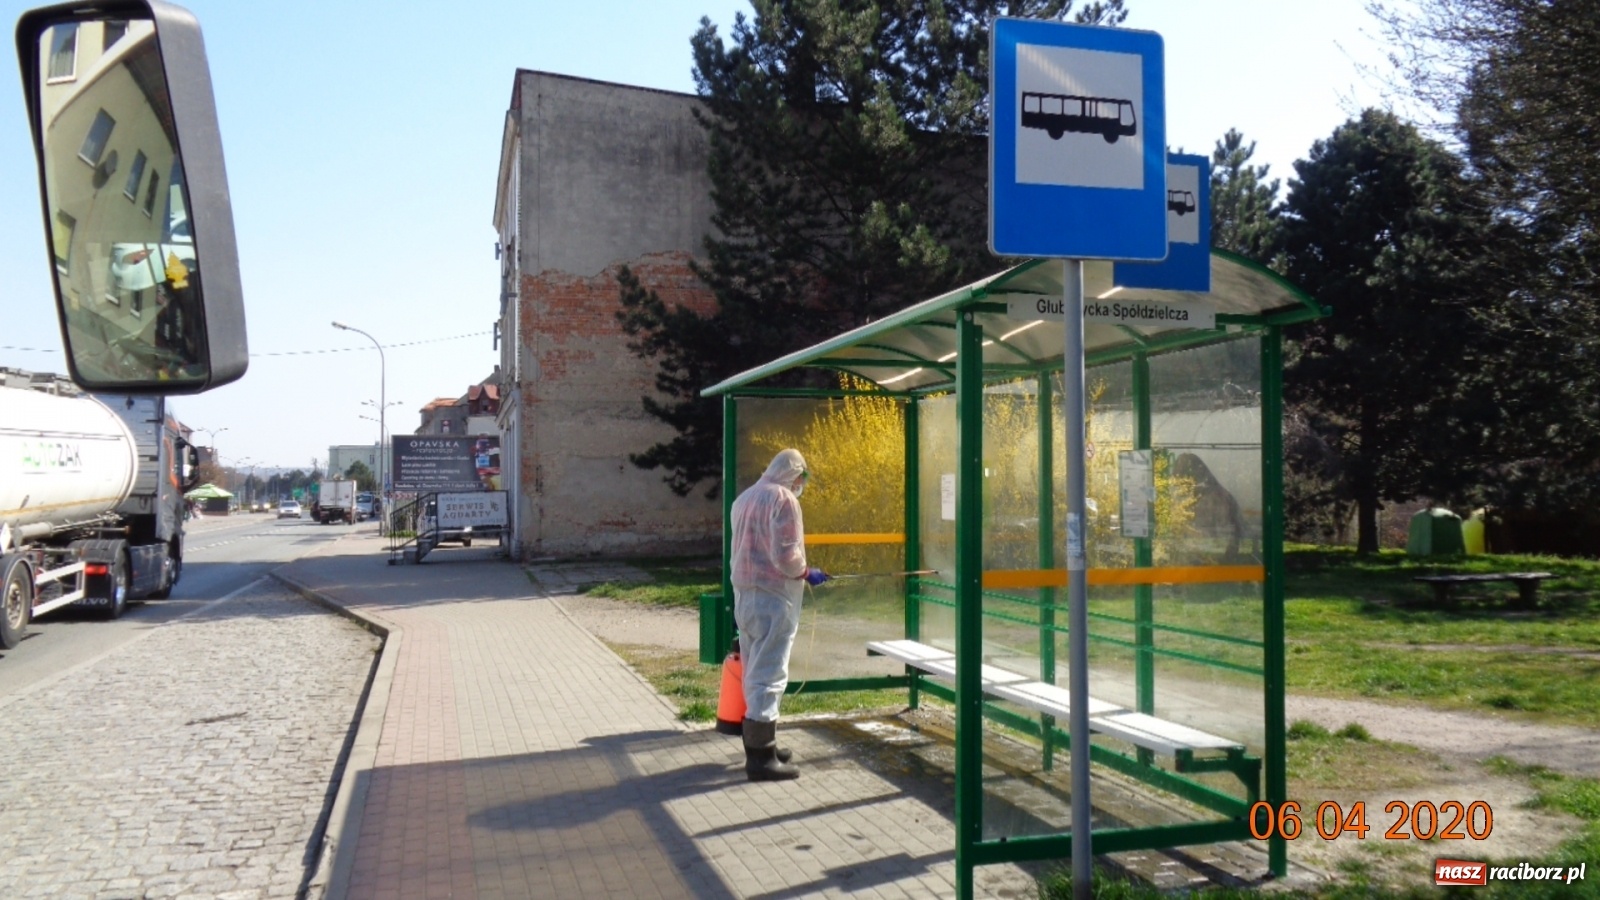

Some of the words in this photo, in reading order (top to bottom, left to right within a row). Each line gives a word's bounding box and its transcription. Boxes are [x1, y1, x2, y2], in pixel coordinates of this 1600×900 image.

[1036, 299, 1109, 317] Głubycka
[1113, 303, 1189, 321] Spółdzielcza
[409, 440, 459, 448] OPAVSKA
[22, 441, 82, 467] AUTOZAK
[446, 502, 485, 511] SERWIS
